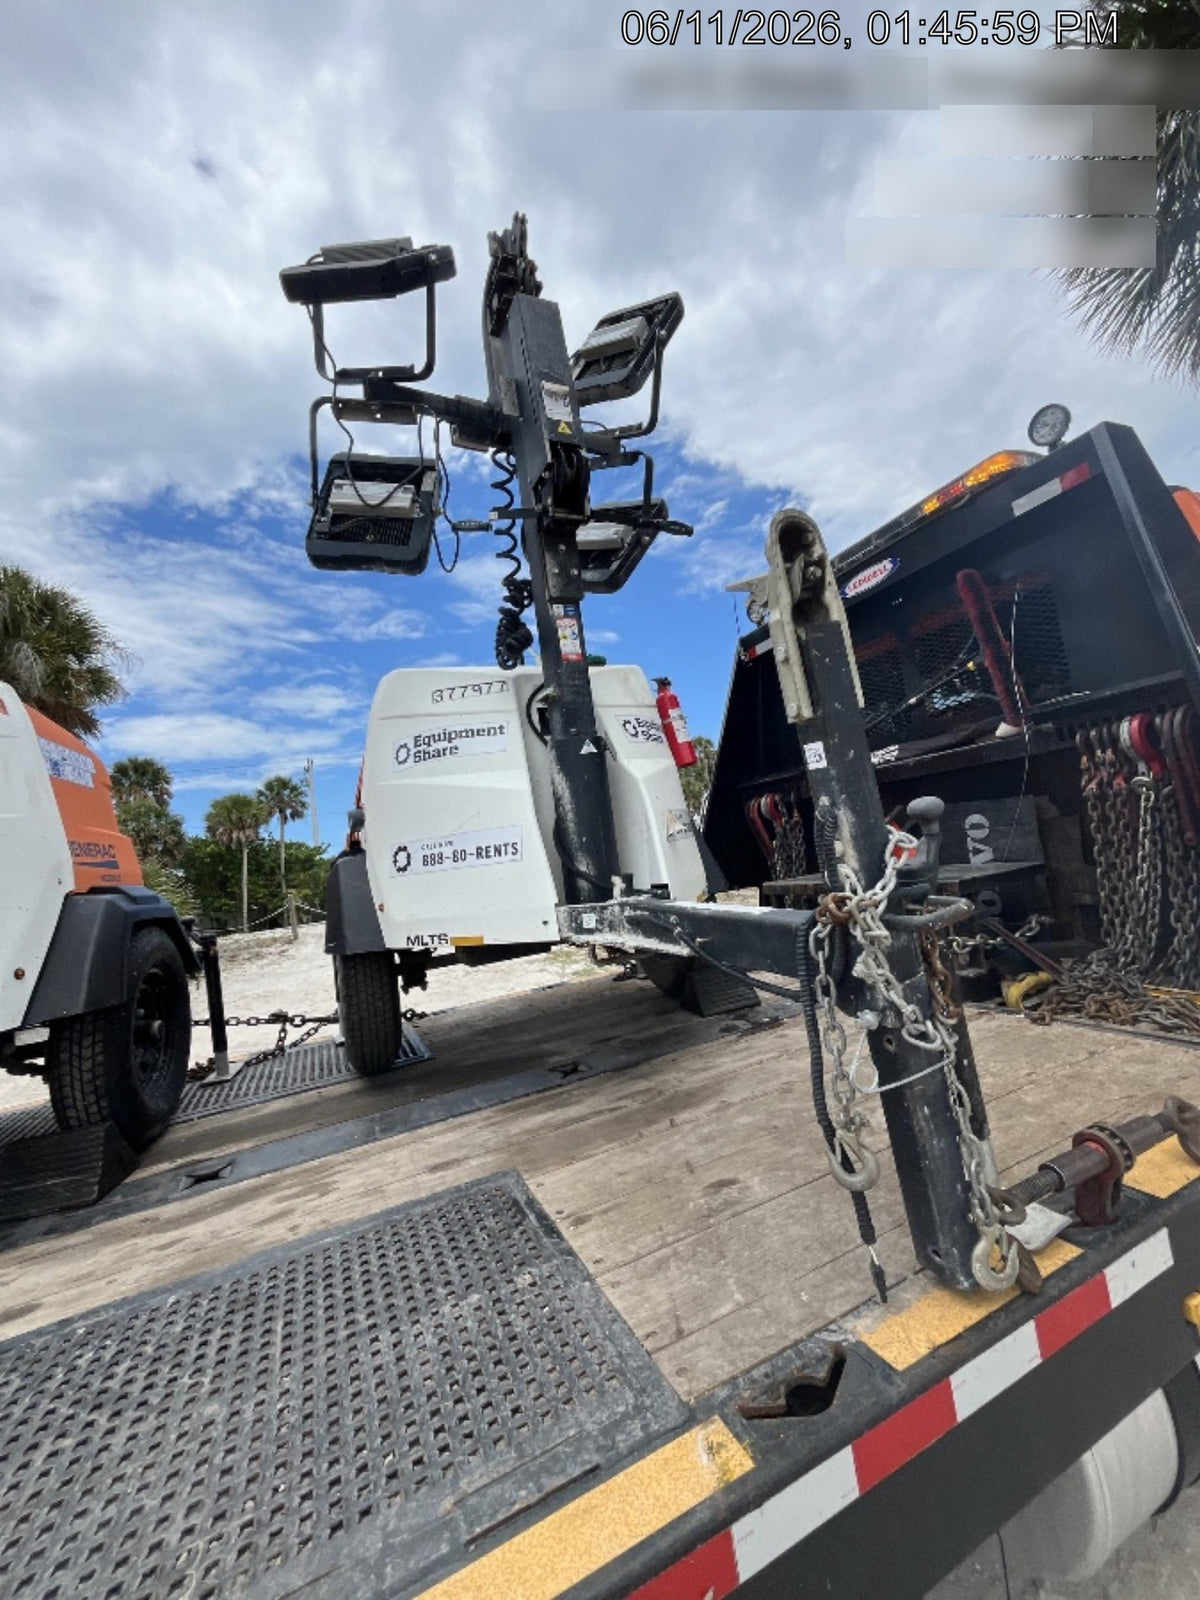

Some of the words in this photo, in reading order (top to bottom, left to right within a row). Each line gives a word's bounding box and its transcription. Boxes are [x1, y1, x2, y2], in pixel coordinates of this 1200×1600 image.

[413, 724, 505, 748] Equipment
[413, 745, 459, 763] Share
[68, 840, 117, 858] ENERAC
[422, 842, 518, 866] 888-80-RENTS
